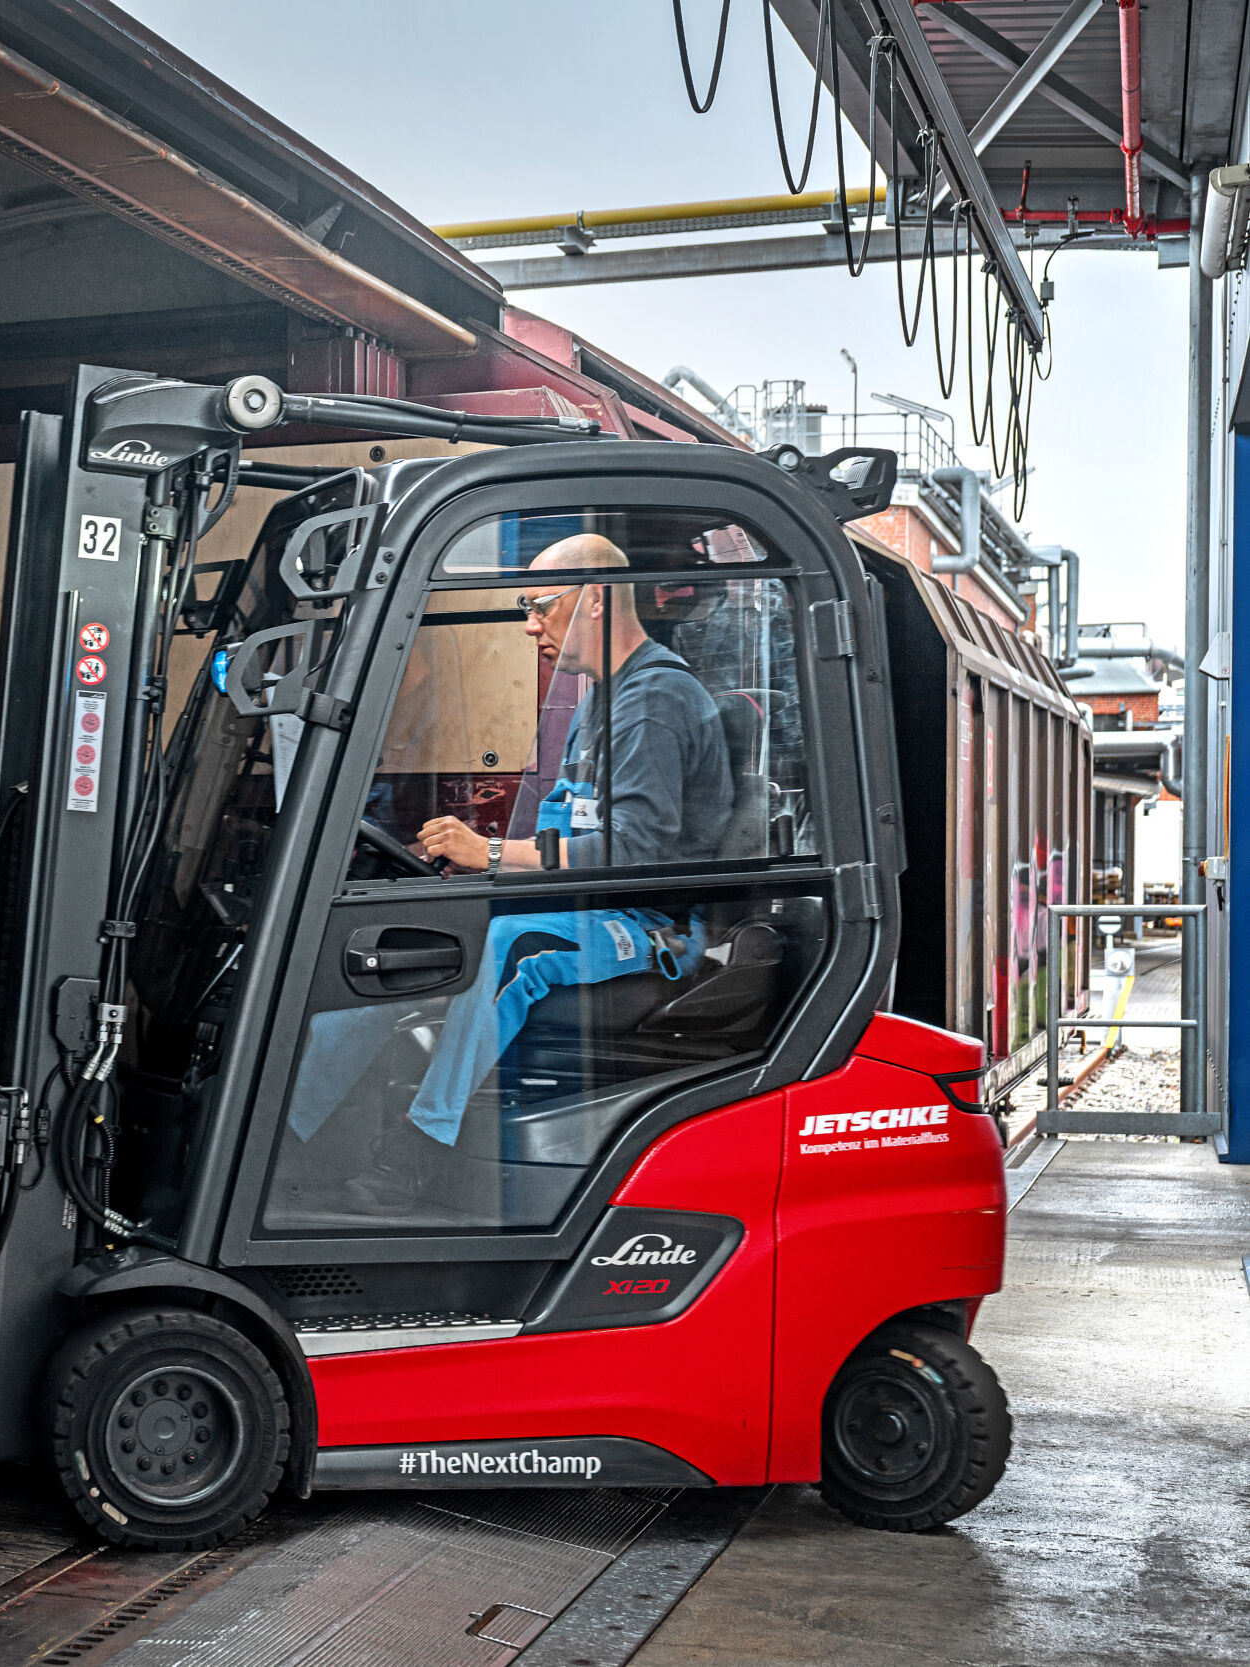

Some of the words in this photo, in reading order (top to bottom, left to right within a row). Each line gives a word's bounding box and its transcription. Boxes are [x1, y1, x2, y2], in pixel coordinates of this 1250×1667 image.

[90, 440, 168, 467] Linde
[83, 520, 117, 557] 32
[798, 1104, 950, 1137] JETSCHKE
[800, 1139, 862, 1156] Kompetenz
[863, 1138, 880, 1150] im
[881, 1131, 950, 1148] Materialfluss
[591, 1233, 697, 1266] Linde
[398, 1449, 602, 1480] #TheNextChamp
